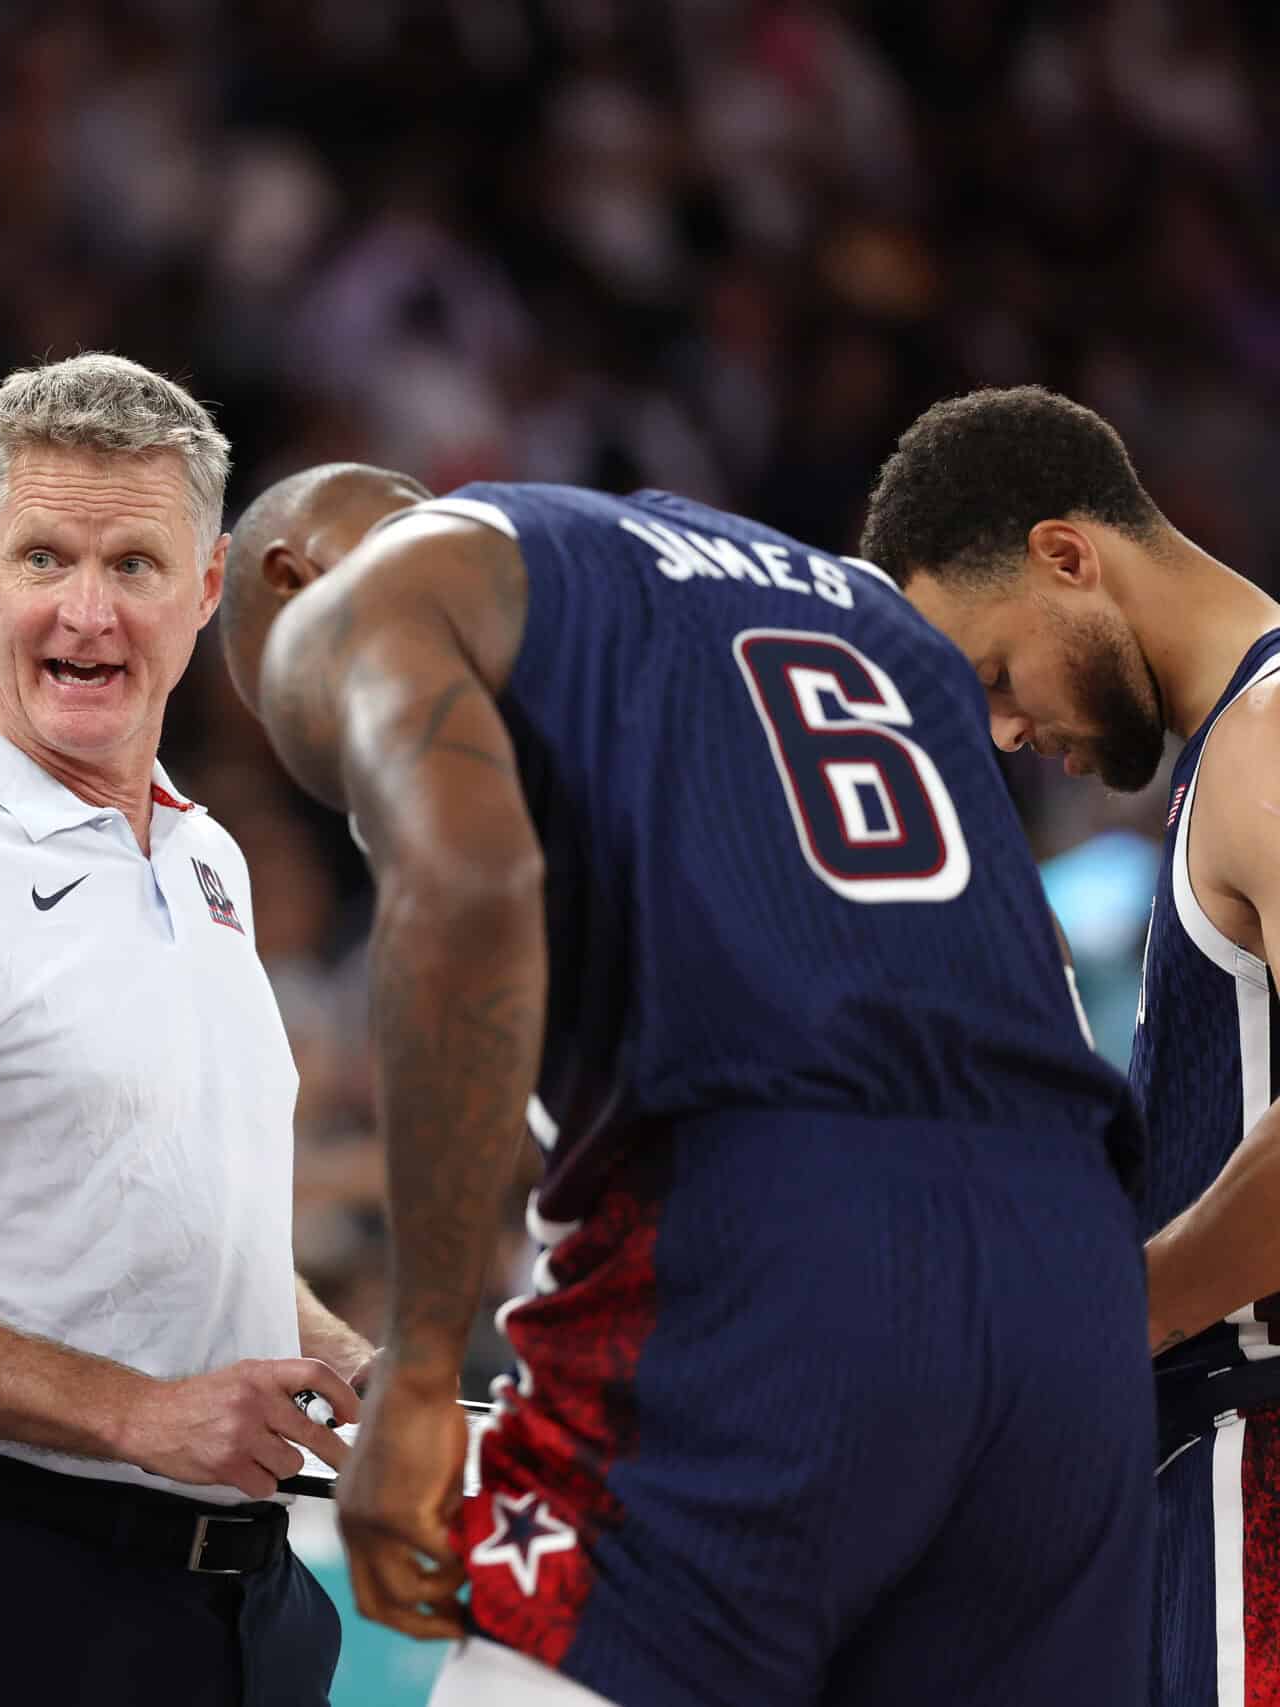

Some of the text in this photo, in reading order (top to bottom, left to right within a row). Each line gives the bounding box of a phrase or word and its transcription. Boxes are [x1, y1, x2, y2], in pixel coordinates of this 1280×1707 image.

[620, 517, 854, 609] JAMES
[732, 628, 971, 903] 6
[190, 856, 239, 921] USA
